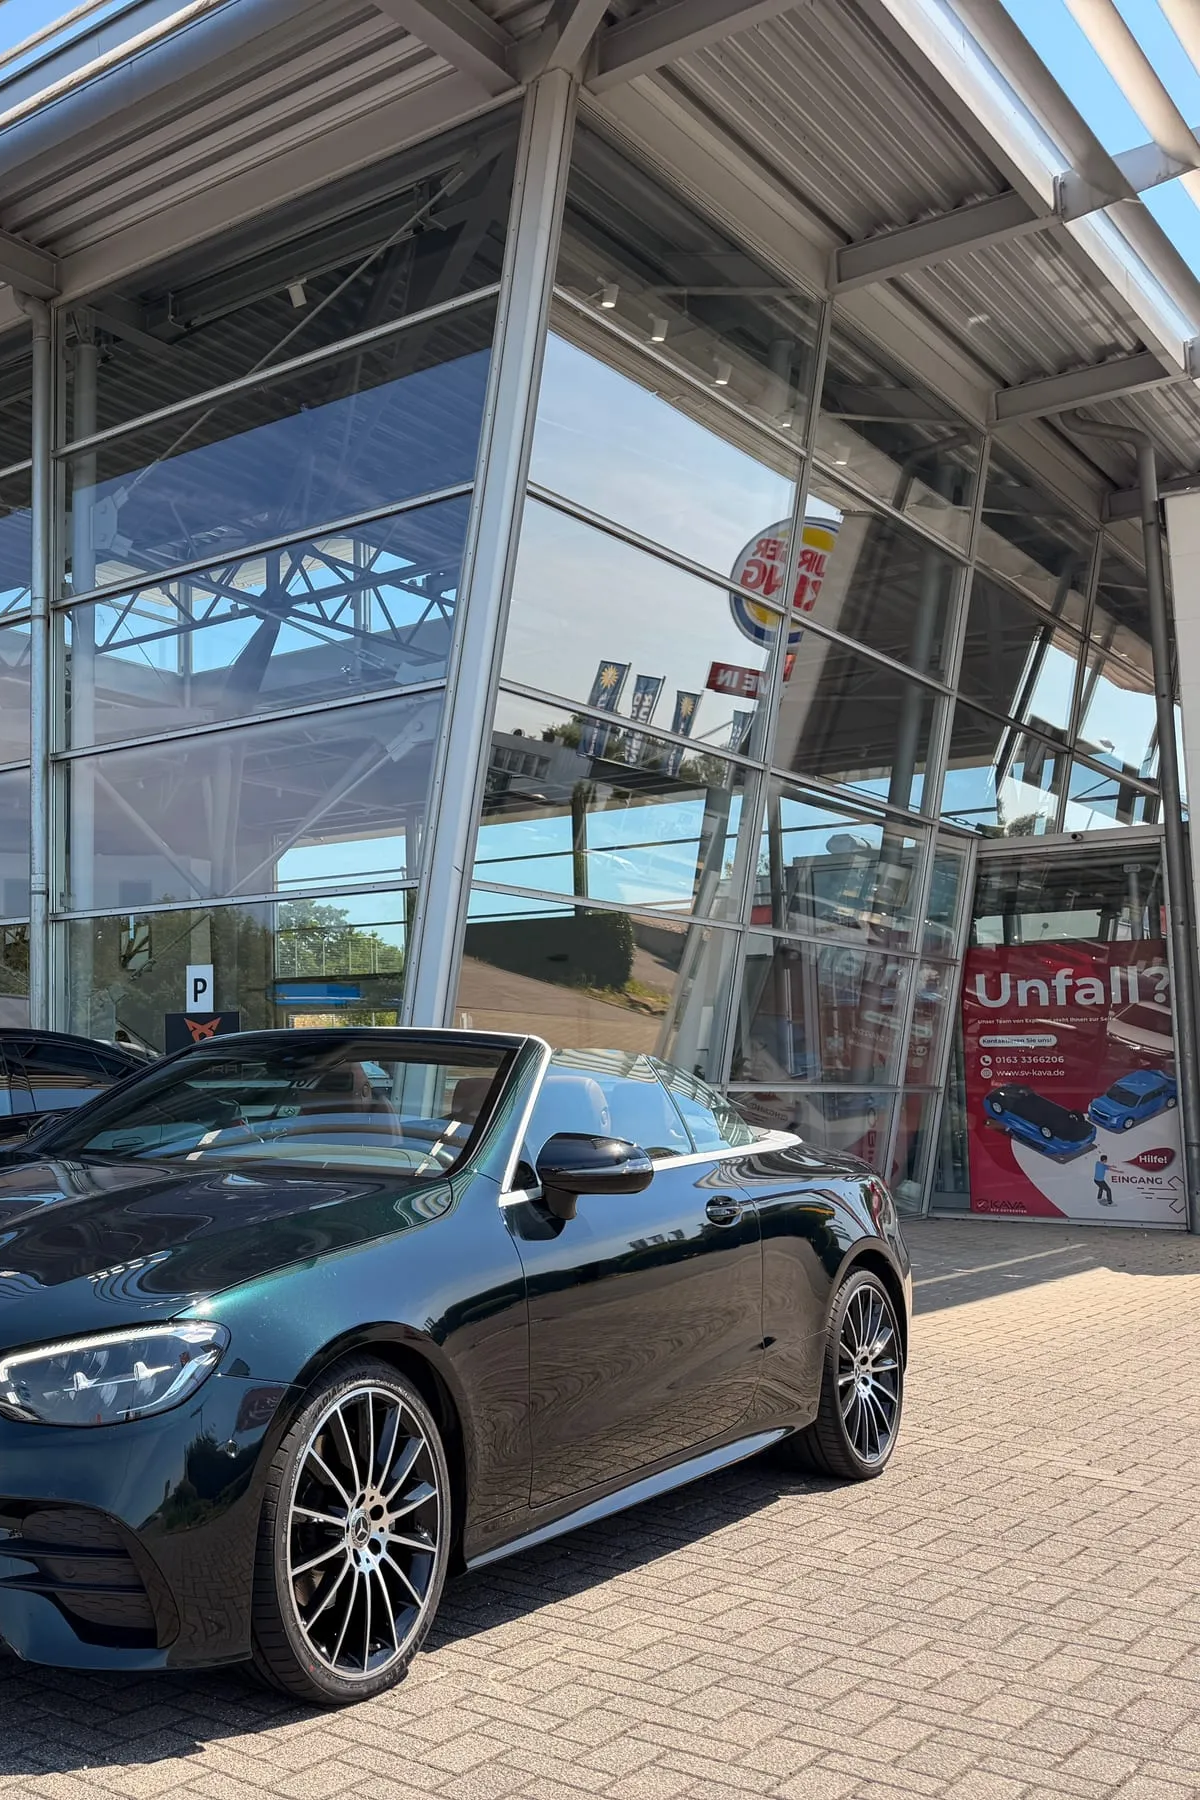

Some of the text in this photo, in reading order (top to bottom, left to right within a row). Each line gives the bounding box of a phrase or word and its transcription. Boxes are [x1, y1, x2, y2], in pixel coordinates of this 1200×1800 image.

[193, 977, 207, 1002] P
[975, 965, 1170, 1008] Unfall?
[982, 1037, 1025, 1045] Kontakren
[995, 1055, 1064, 1064] 0163 3366206
[996, 1068, 1065, 1077] www.sv-kava.de
[1138, 1154, 1168, 1165] Hilfe!
[1111, 1175, 1163, 1185] EINGANG
